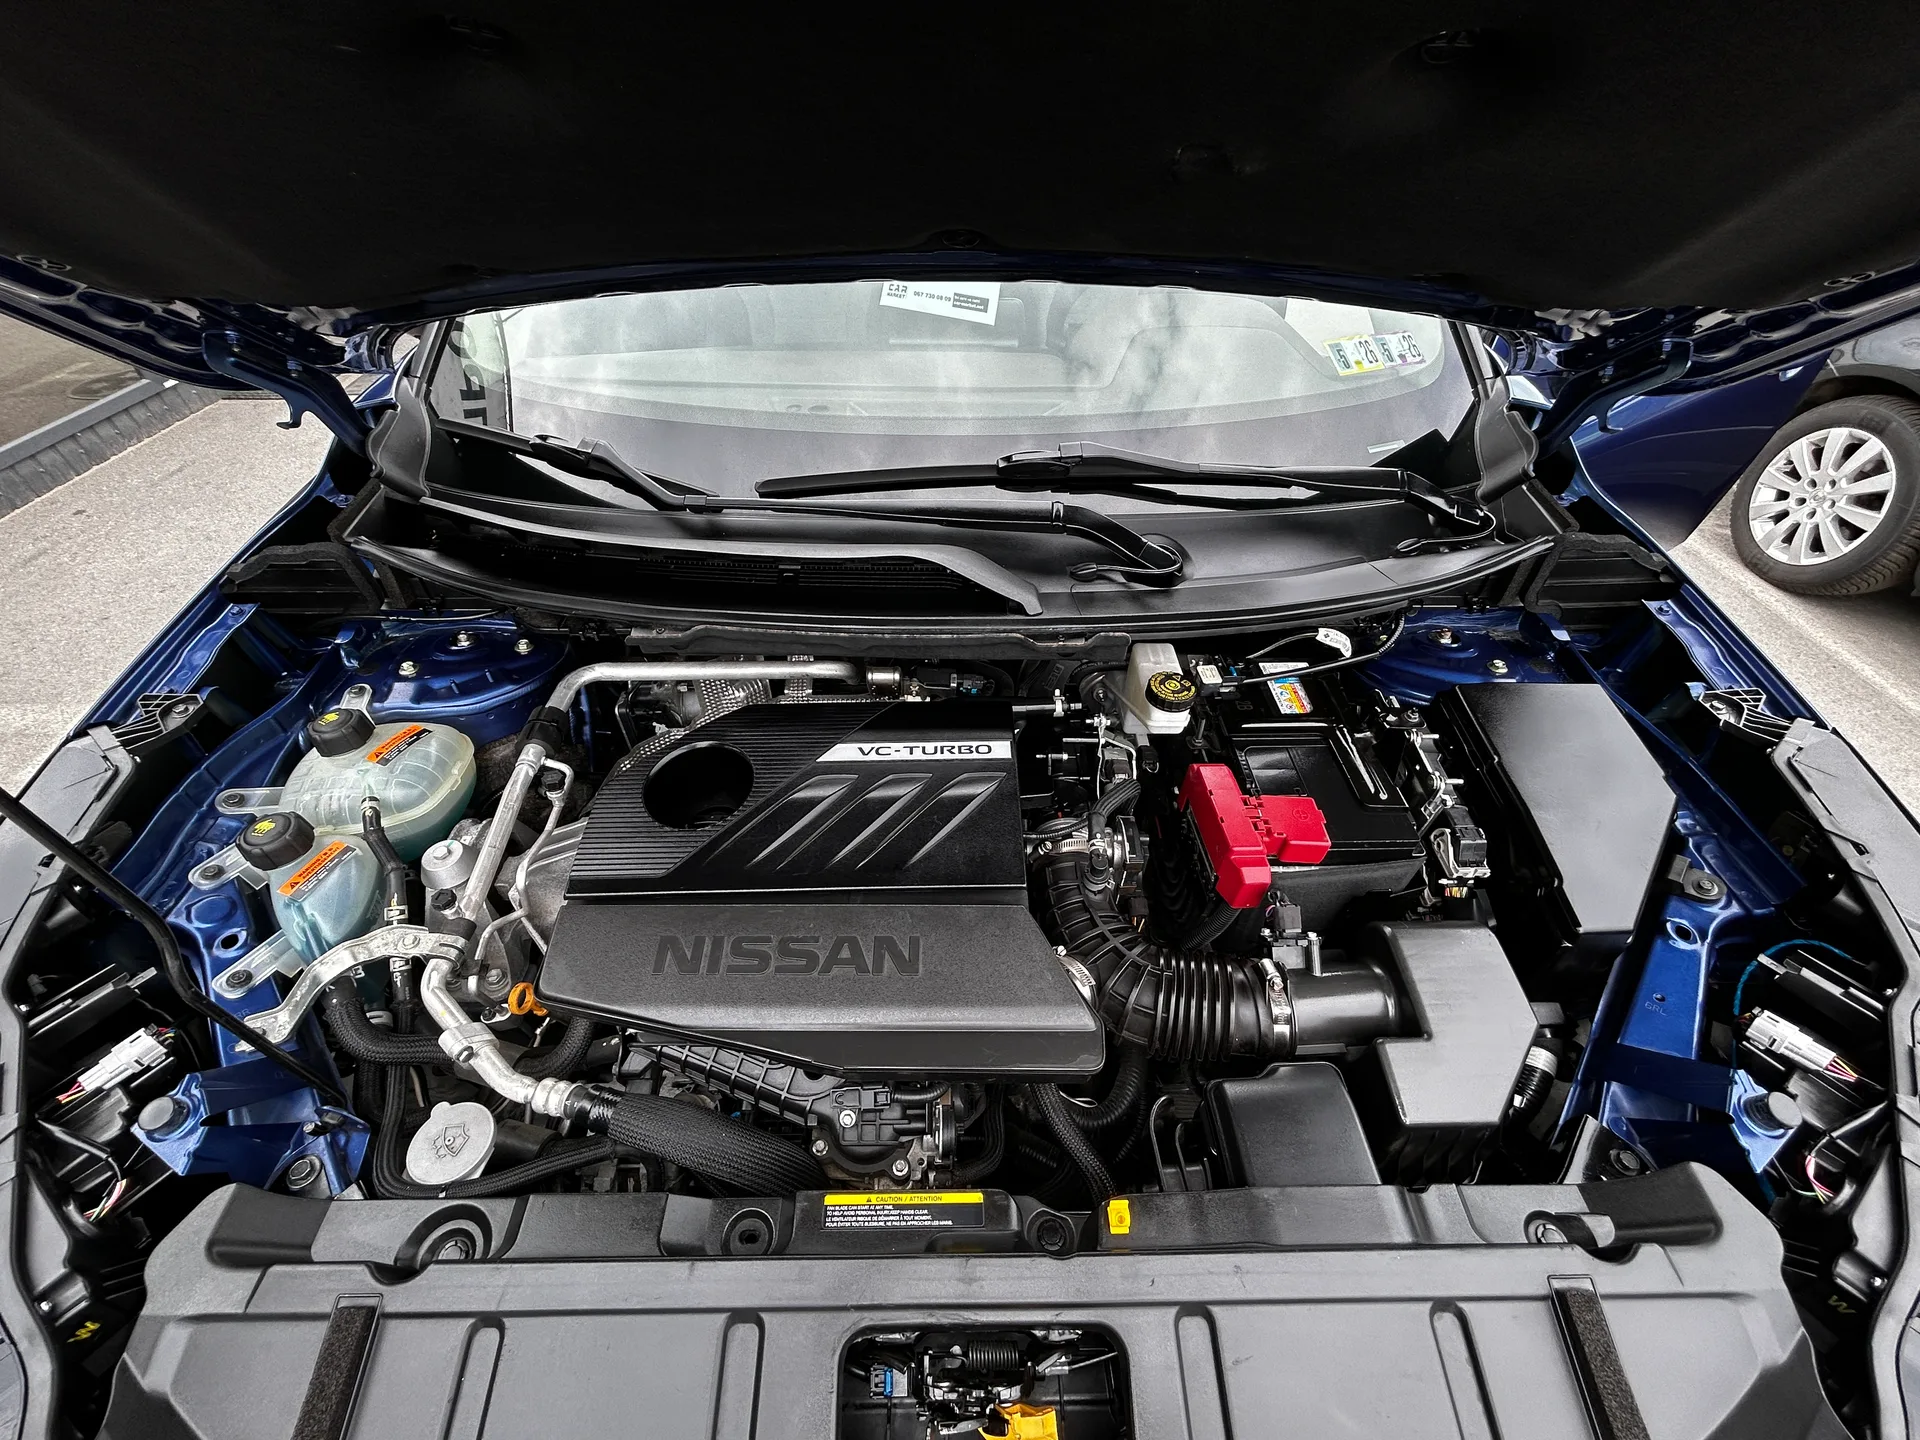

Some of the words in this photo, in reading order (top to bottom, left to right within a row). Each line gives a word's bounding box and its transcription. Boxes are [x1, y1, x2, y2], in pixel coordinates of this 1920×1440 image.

[889, 283, 908, 293] CAR
[1359, 339, 1379, 364] 26
[857, 744, 992, 756] VC-TURBO
[651, 934, 921, 976] NISSAN
